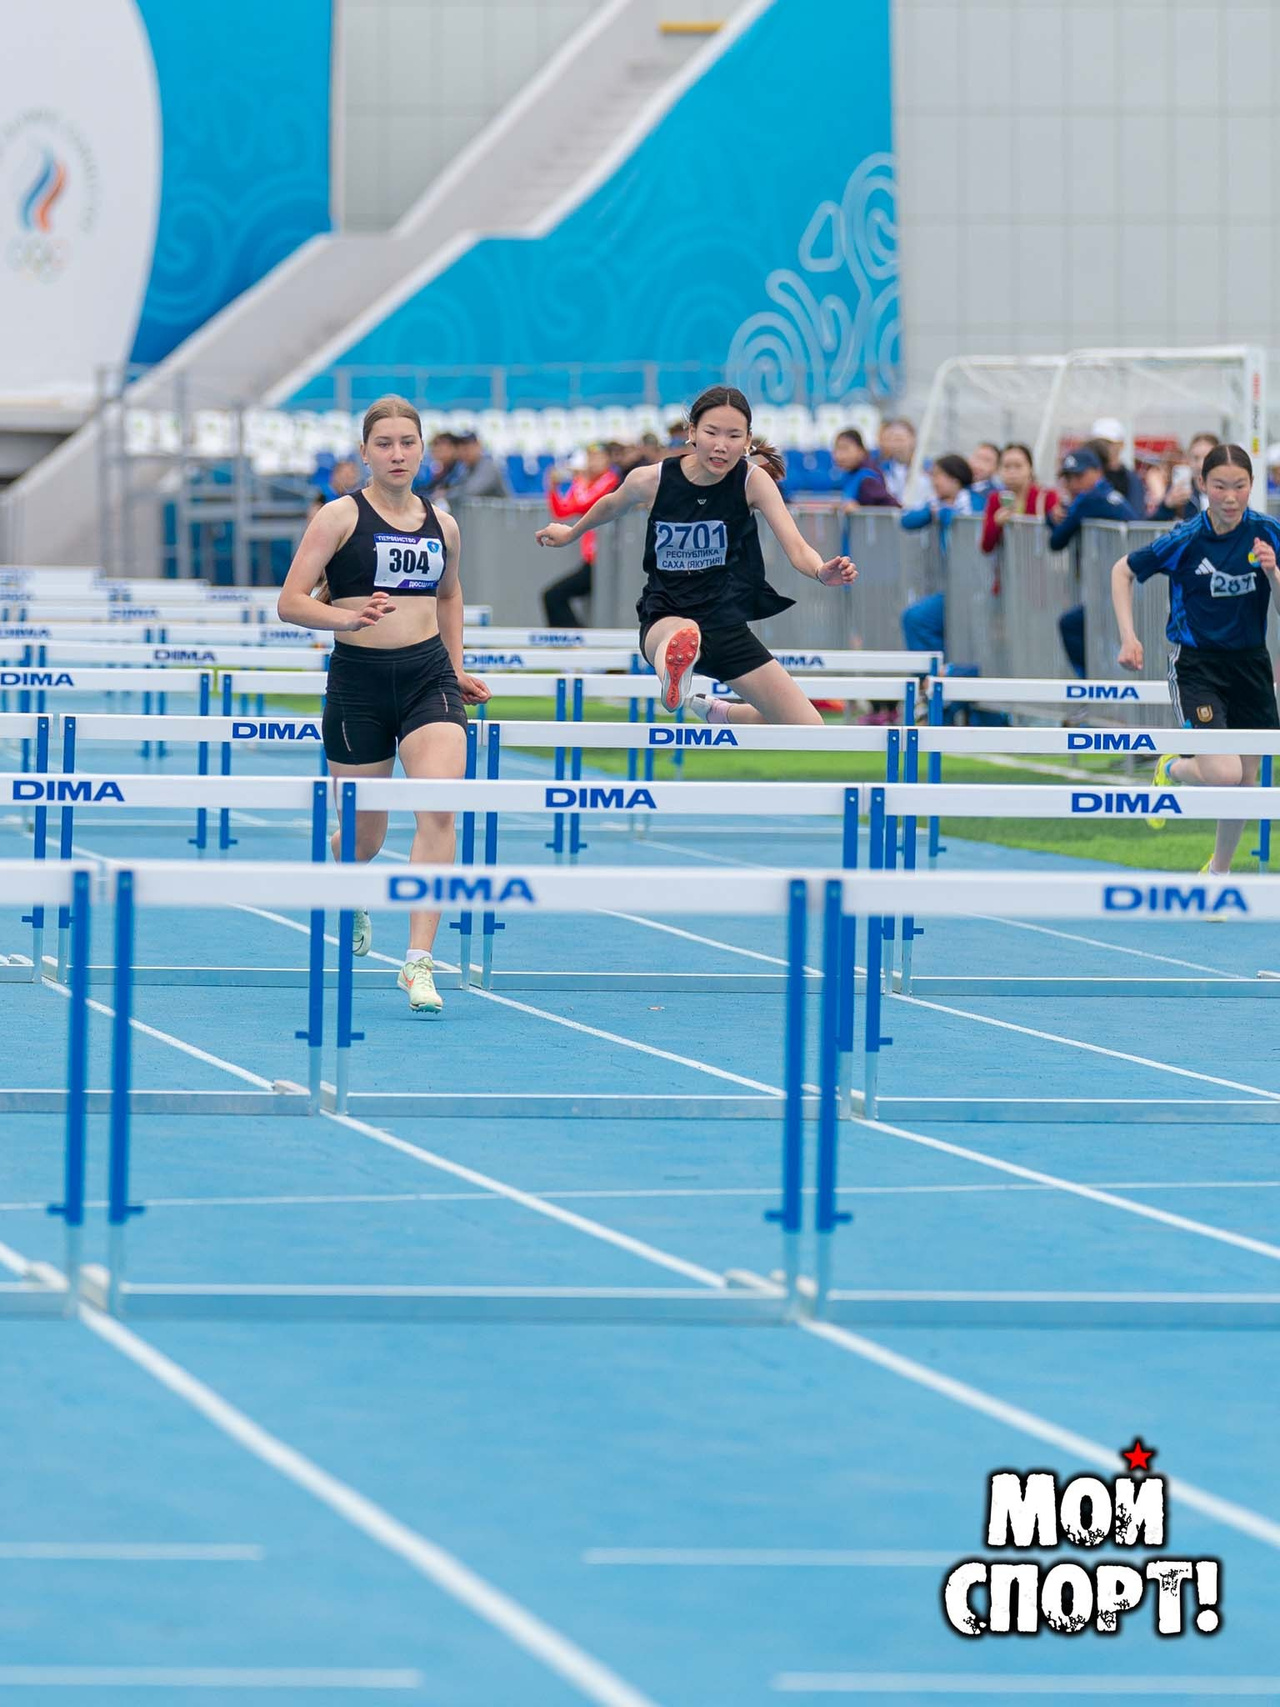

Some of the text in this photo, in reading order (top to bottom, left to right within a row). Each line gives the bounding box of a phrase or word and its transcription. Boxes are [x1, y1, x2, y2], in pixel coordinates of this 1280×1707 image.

[657, 523, 725, 550] 2701
[389, 548, 430, 575] 304
[666, 549, 719, 559] РЕСПУБЛИКА
[662, 560, 685, 569] САХА
[154, 650, 216, 662] DIMA
[774, 655, 825, 668] IMA
[0, 672, 74, 687] DIMA
[1067, 686, 1140, 700] DIMA
[232, 722, 321, 740] DIMA
[649, 728, 738, 746] DIMA
[1068, 734, 1157, 750] DIMA
[13, 780, 125, 802] DIMA
[545, 788, 657, 809] DIMA
[1071, 793, 1182, 814] DIMA
[387, 875, 536, 903] DIMA
[1103, 884, 1249, 913] DIMA
